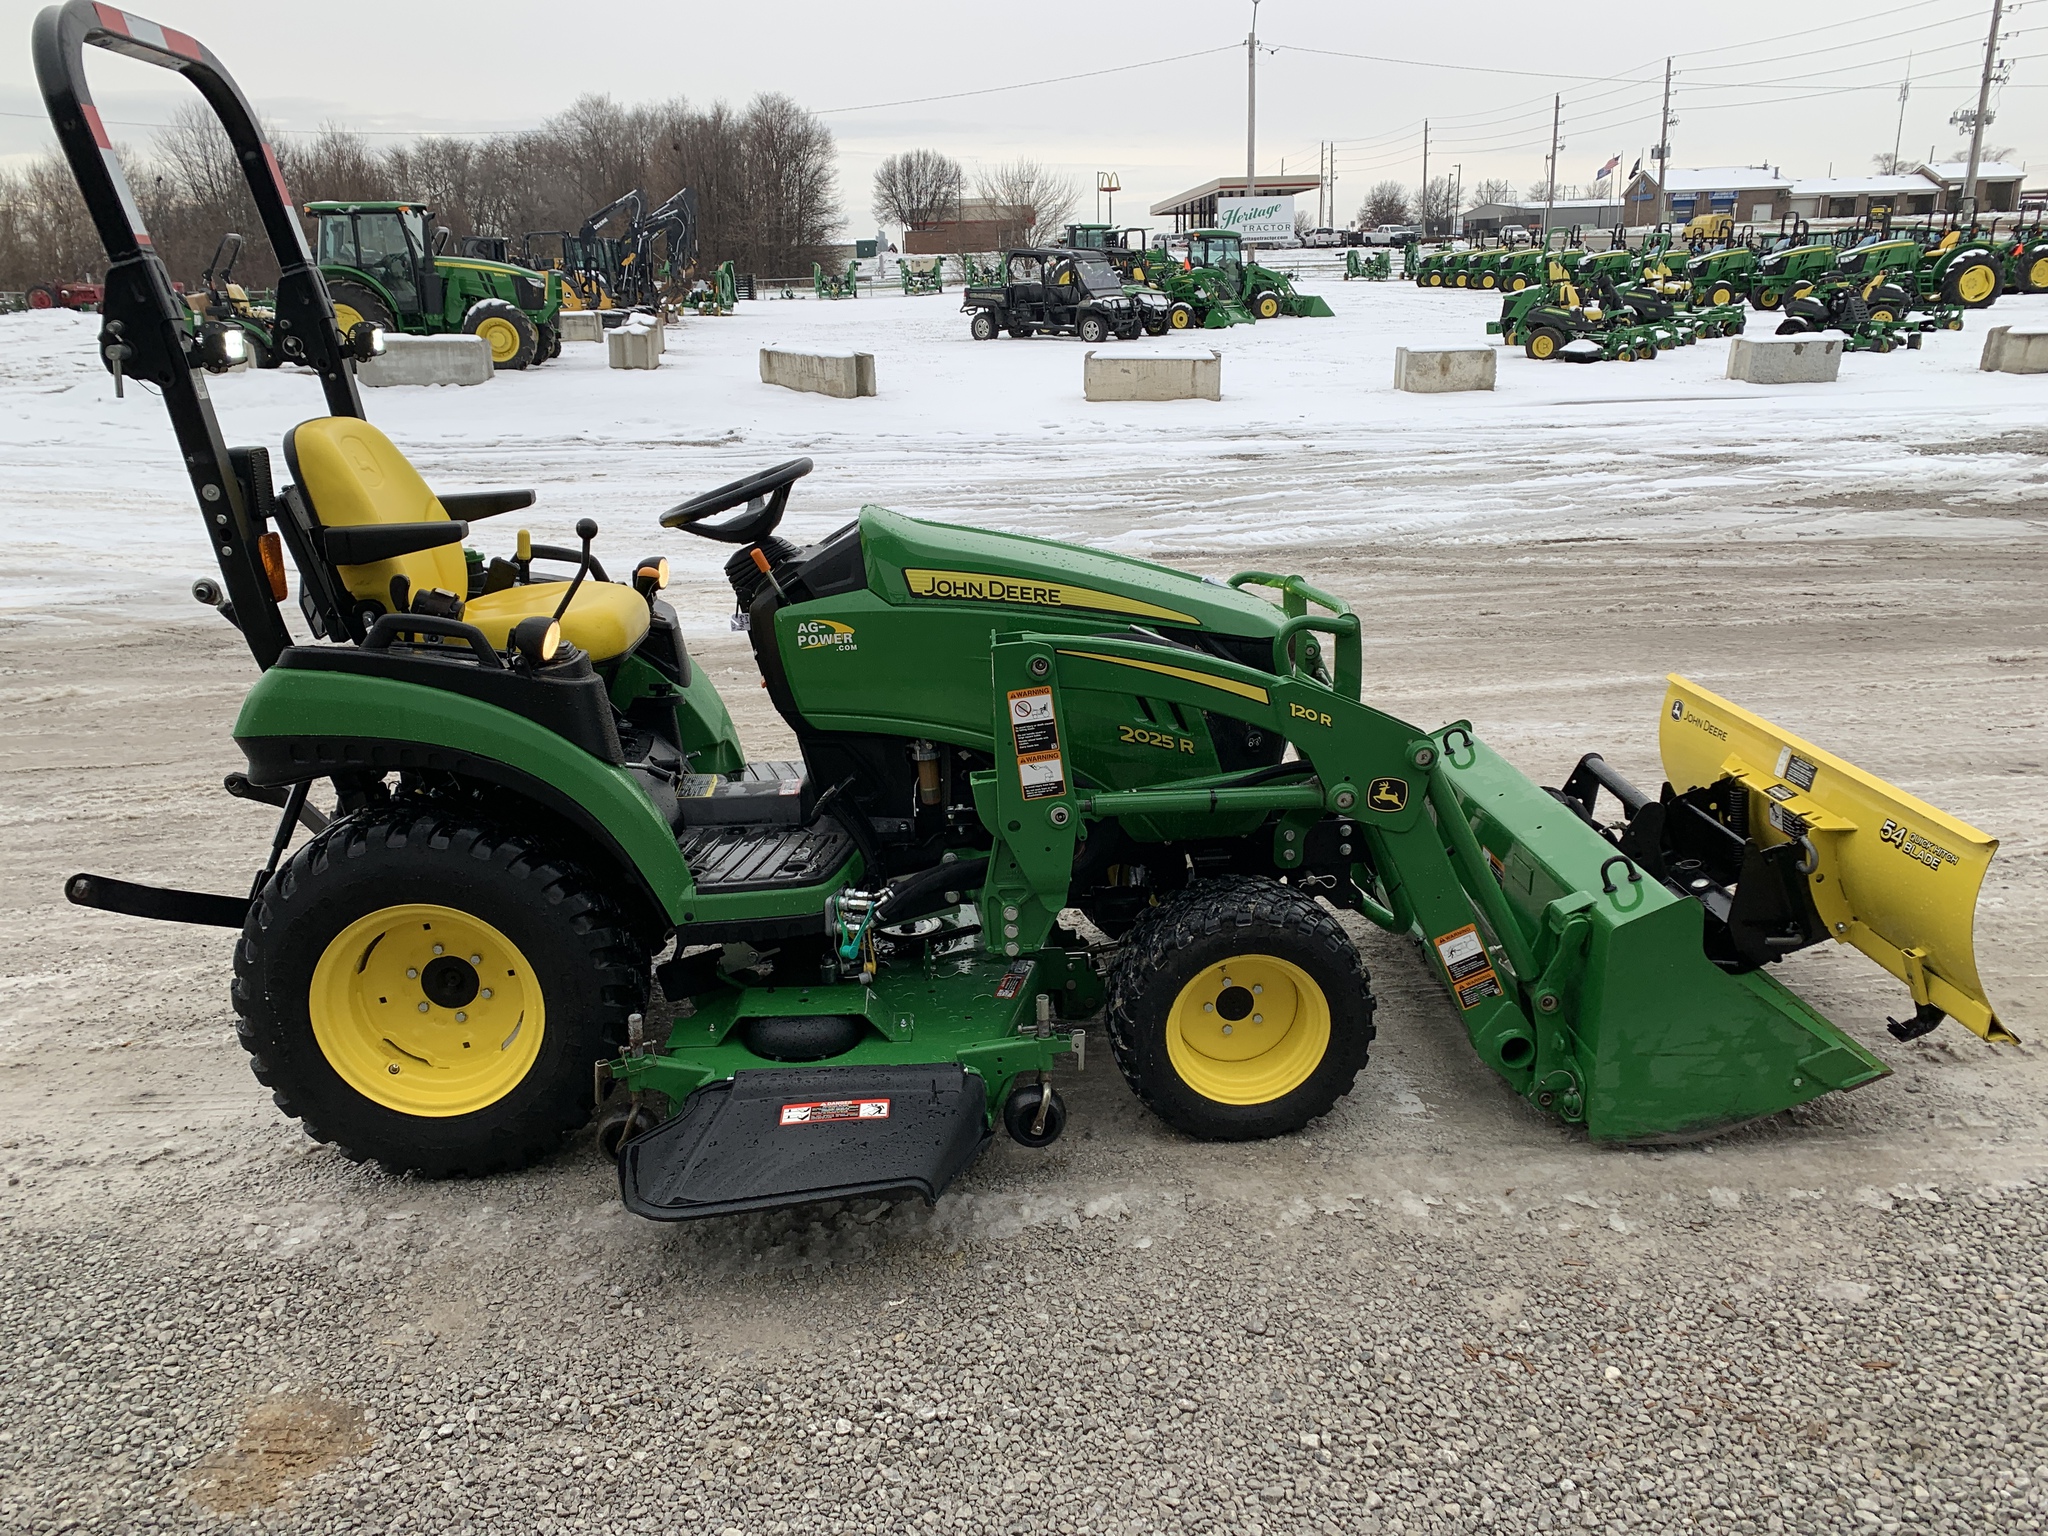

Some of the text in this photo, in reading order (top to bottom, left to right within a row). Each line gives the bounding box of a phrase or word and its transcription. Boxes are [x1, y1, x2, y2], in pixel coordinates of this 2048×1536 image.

[593, 217, 609, 230] DEERE
[1220, 204, 1281, 229] Heritage
[1242, 224, 1291, 232] TRACTOR
[924, 577, 1061, 604] JOHN DEERE
[797, 622, 826, 633] AG-
[797, 633, 853, 647] POWER
[836, 644, 858, 652] .COM
[1016, 687, 1050, 699] WARNING
[1289, 702, 1332, 727] 120 R
[1683, 710, 1728, 742] JOHN DEERE
[1118, 725, 1195, 755] 2025 R
[1025, 753, 1059, 763] WARNING
[1880, 818, 1907, 849] 54
[1902, 841, 1941, 871] BLADE
[1909, 832, 1960, 866] QUICK HITCH
